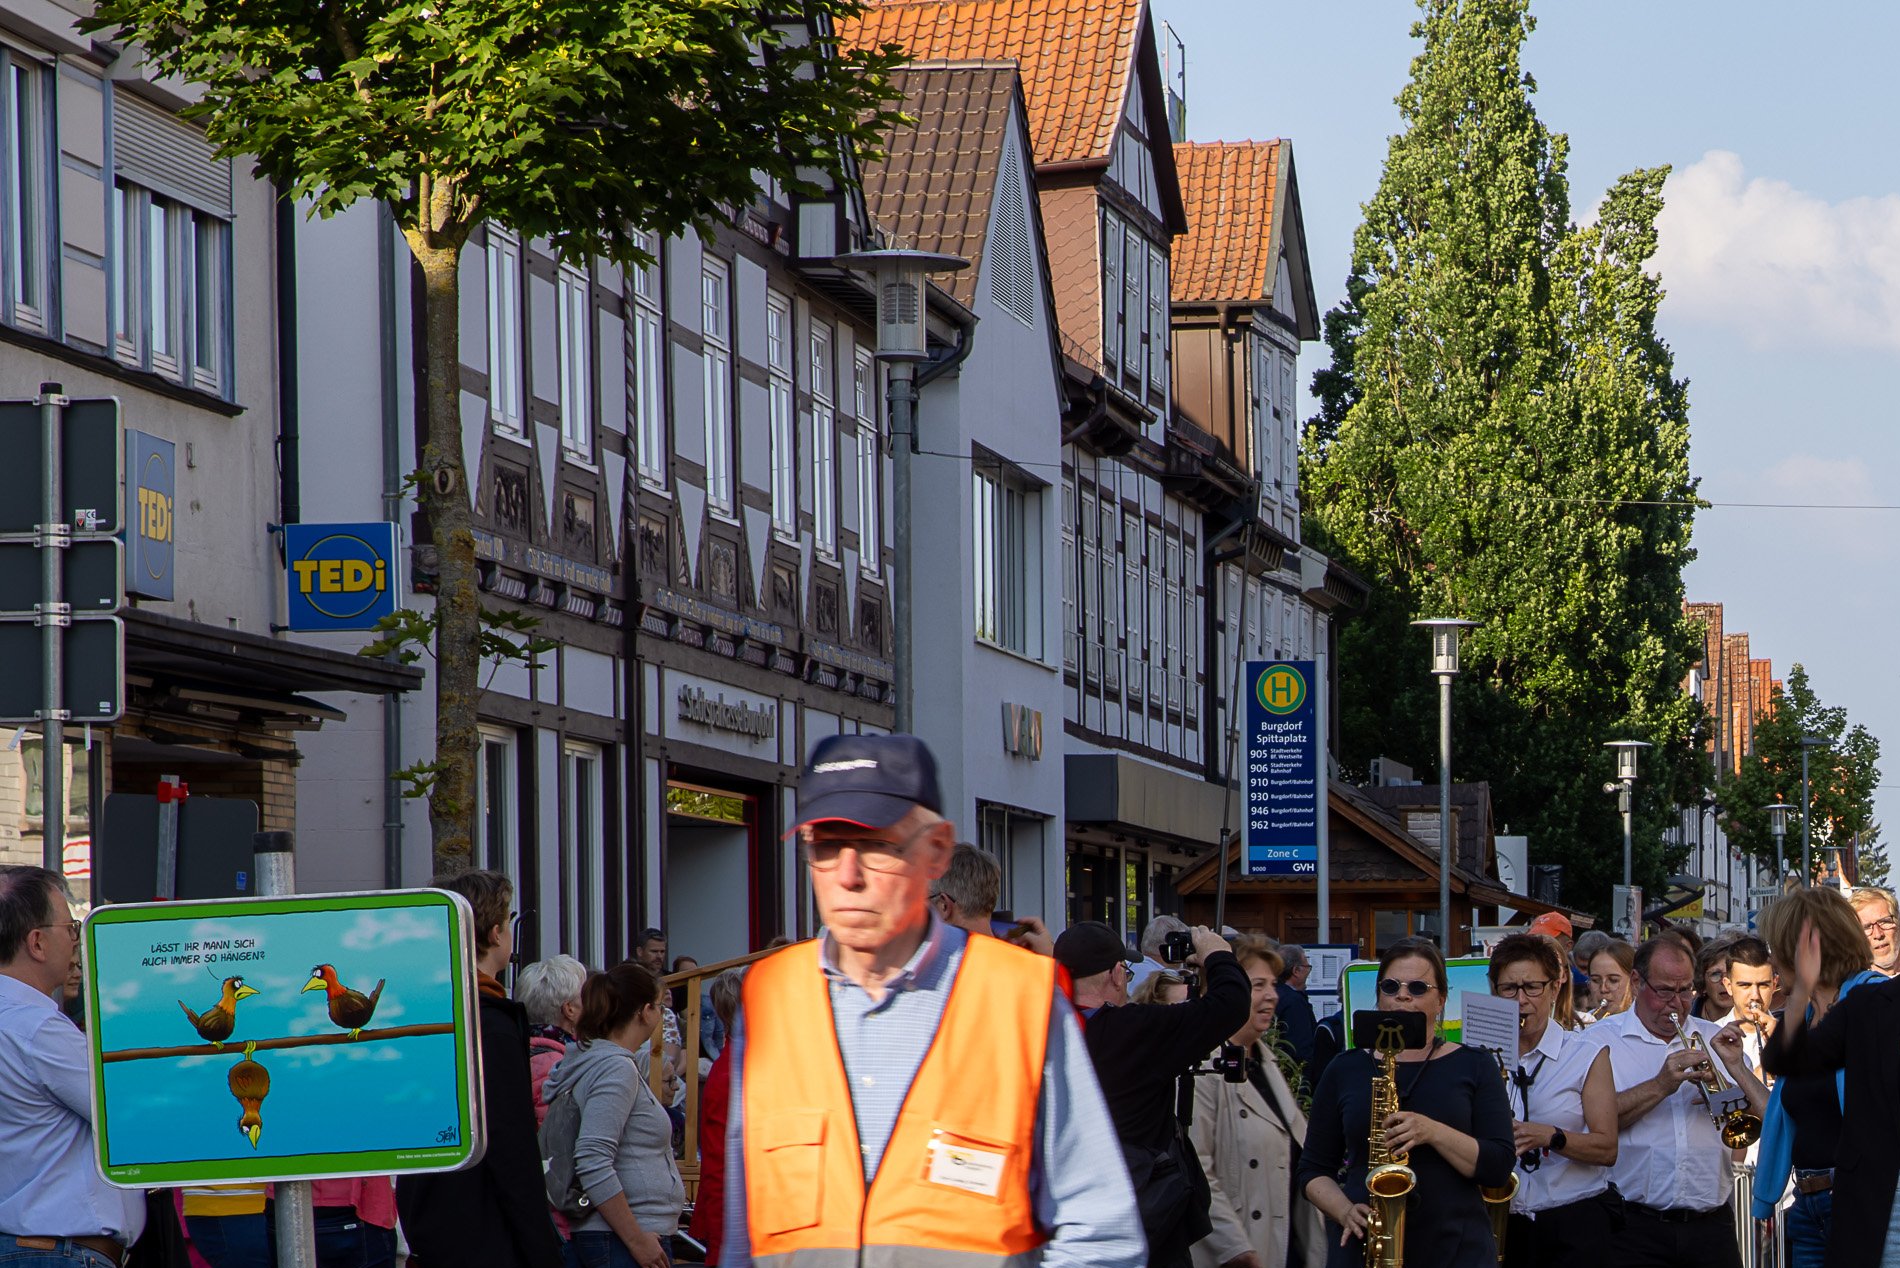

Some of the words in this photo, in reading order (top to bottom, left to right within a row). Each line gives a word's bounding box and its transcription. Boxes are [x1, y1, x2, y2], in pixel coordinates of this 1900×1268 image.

[138, 486, 172, 543] TEDi
[293, 559, 386, 593] TEDi
[1261, 721, 1303, 733] Burgdorf
[1256, 734, 1307, 745] Spittaplatz
[1250, 749, 1268, 759] 905
[1250, 763, 1268, 773] 906
[1250, 778, 1269, 787] 910
[1250, 792, 1269, 801] 930
[1250, 806, 1269, 816] 946
[1251, 820, 1269, 830] 962
[1267, 849, 1290, 858] Zone
[1292, 849, 1299, 858] C
[1292, 863, 1315, 872] GVH
[151, 942, 180, 953] LÄSST
[184, 942, 200, 952] IHR
[203, 940, 230, 950] MANN
[233, 939, 255, 949] SICH
[141, 956, 167, 966] AUCH
[170, 954, 200, 965] IMMER
[203, 953, 217, 963] SO
[220, 949, 265, 962] HÄNGEN?
